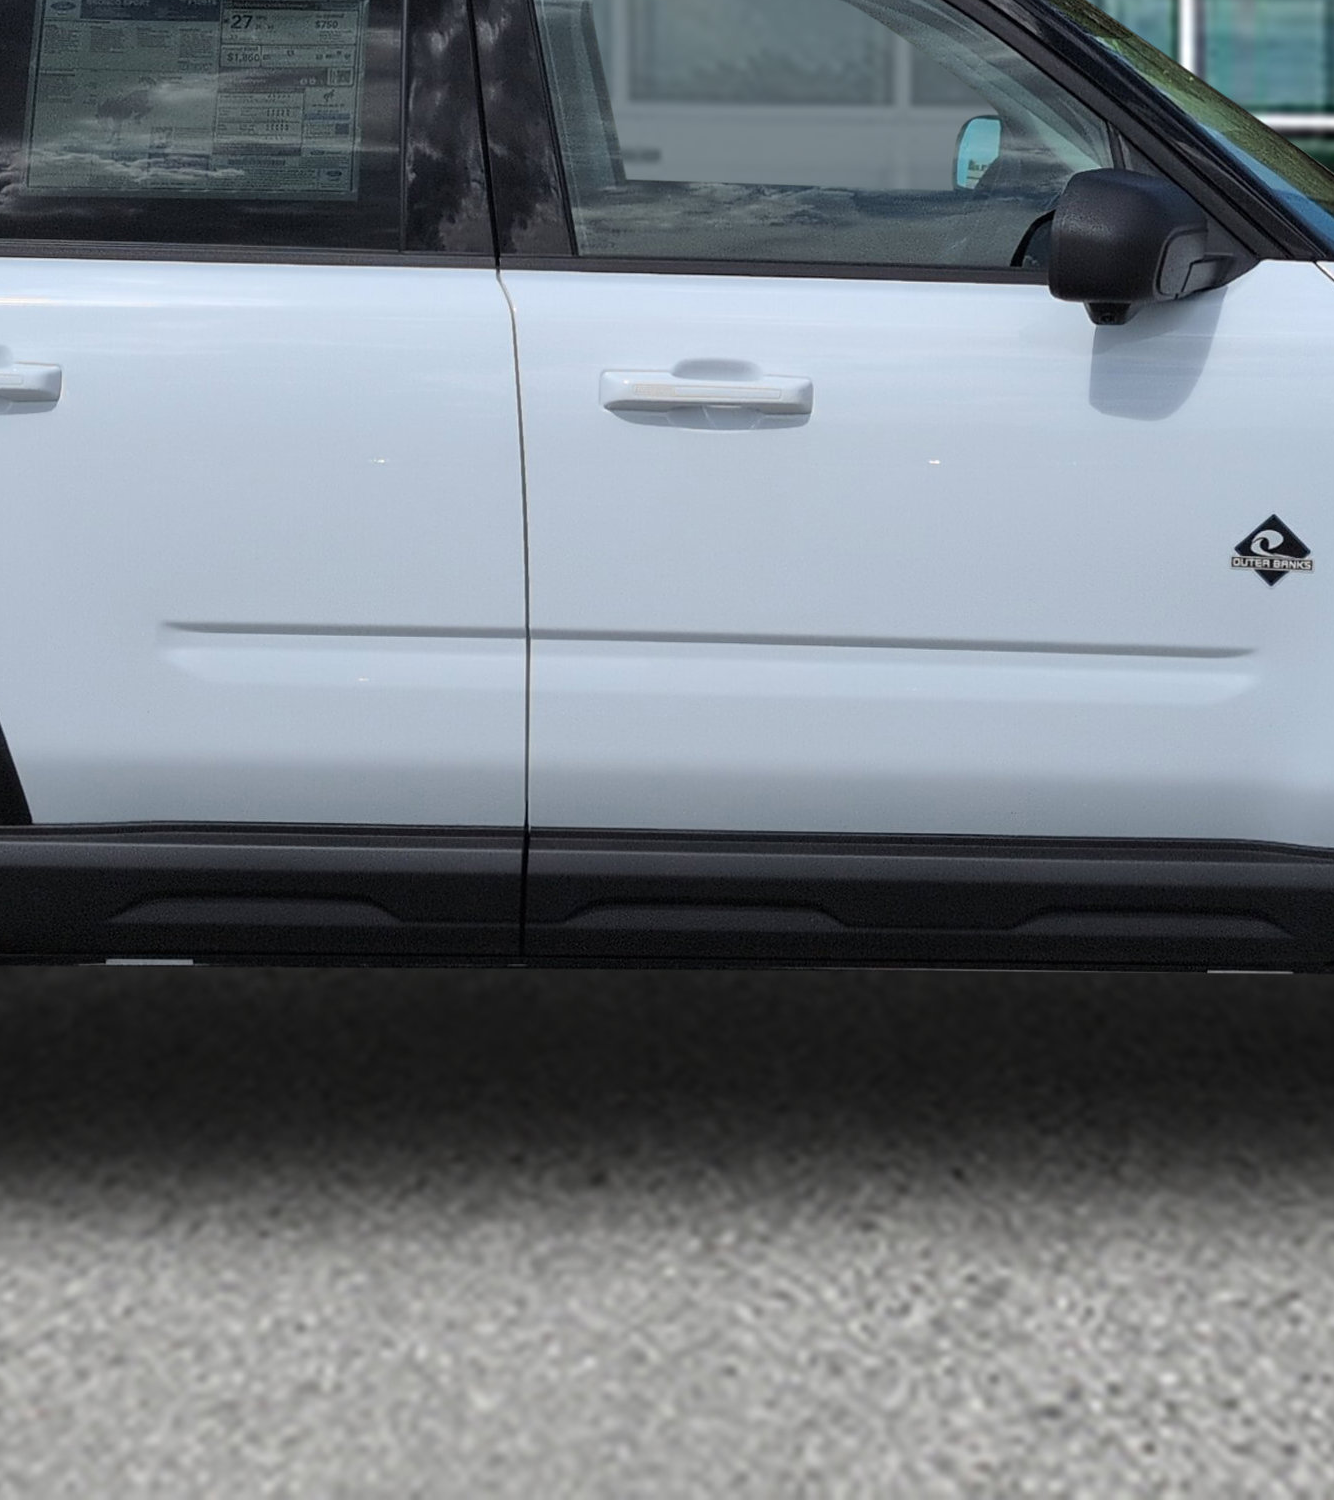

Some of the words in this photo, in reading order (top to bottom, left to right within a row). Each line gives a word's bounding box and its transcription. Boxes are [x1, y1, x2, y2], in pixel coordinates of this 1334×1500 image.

[230, 14, 253, 29] 27
[1233, 557, 1270, 568] OUTER
[1273, 559, 1311, 570] BANKS
